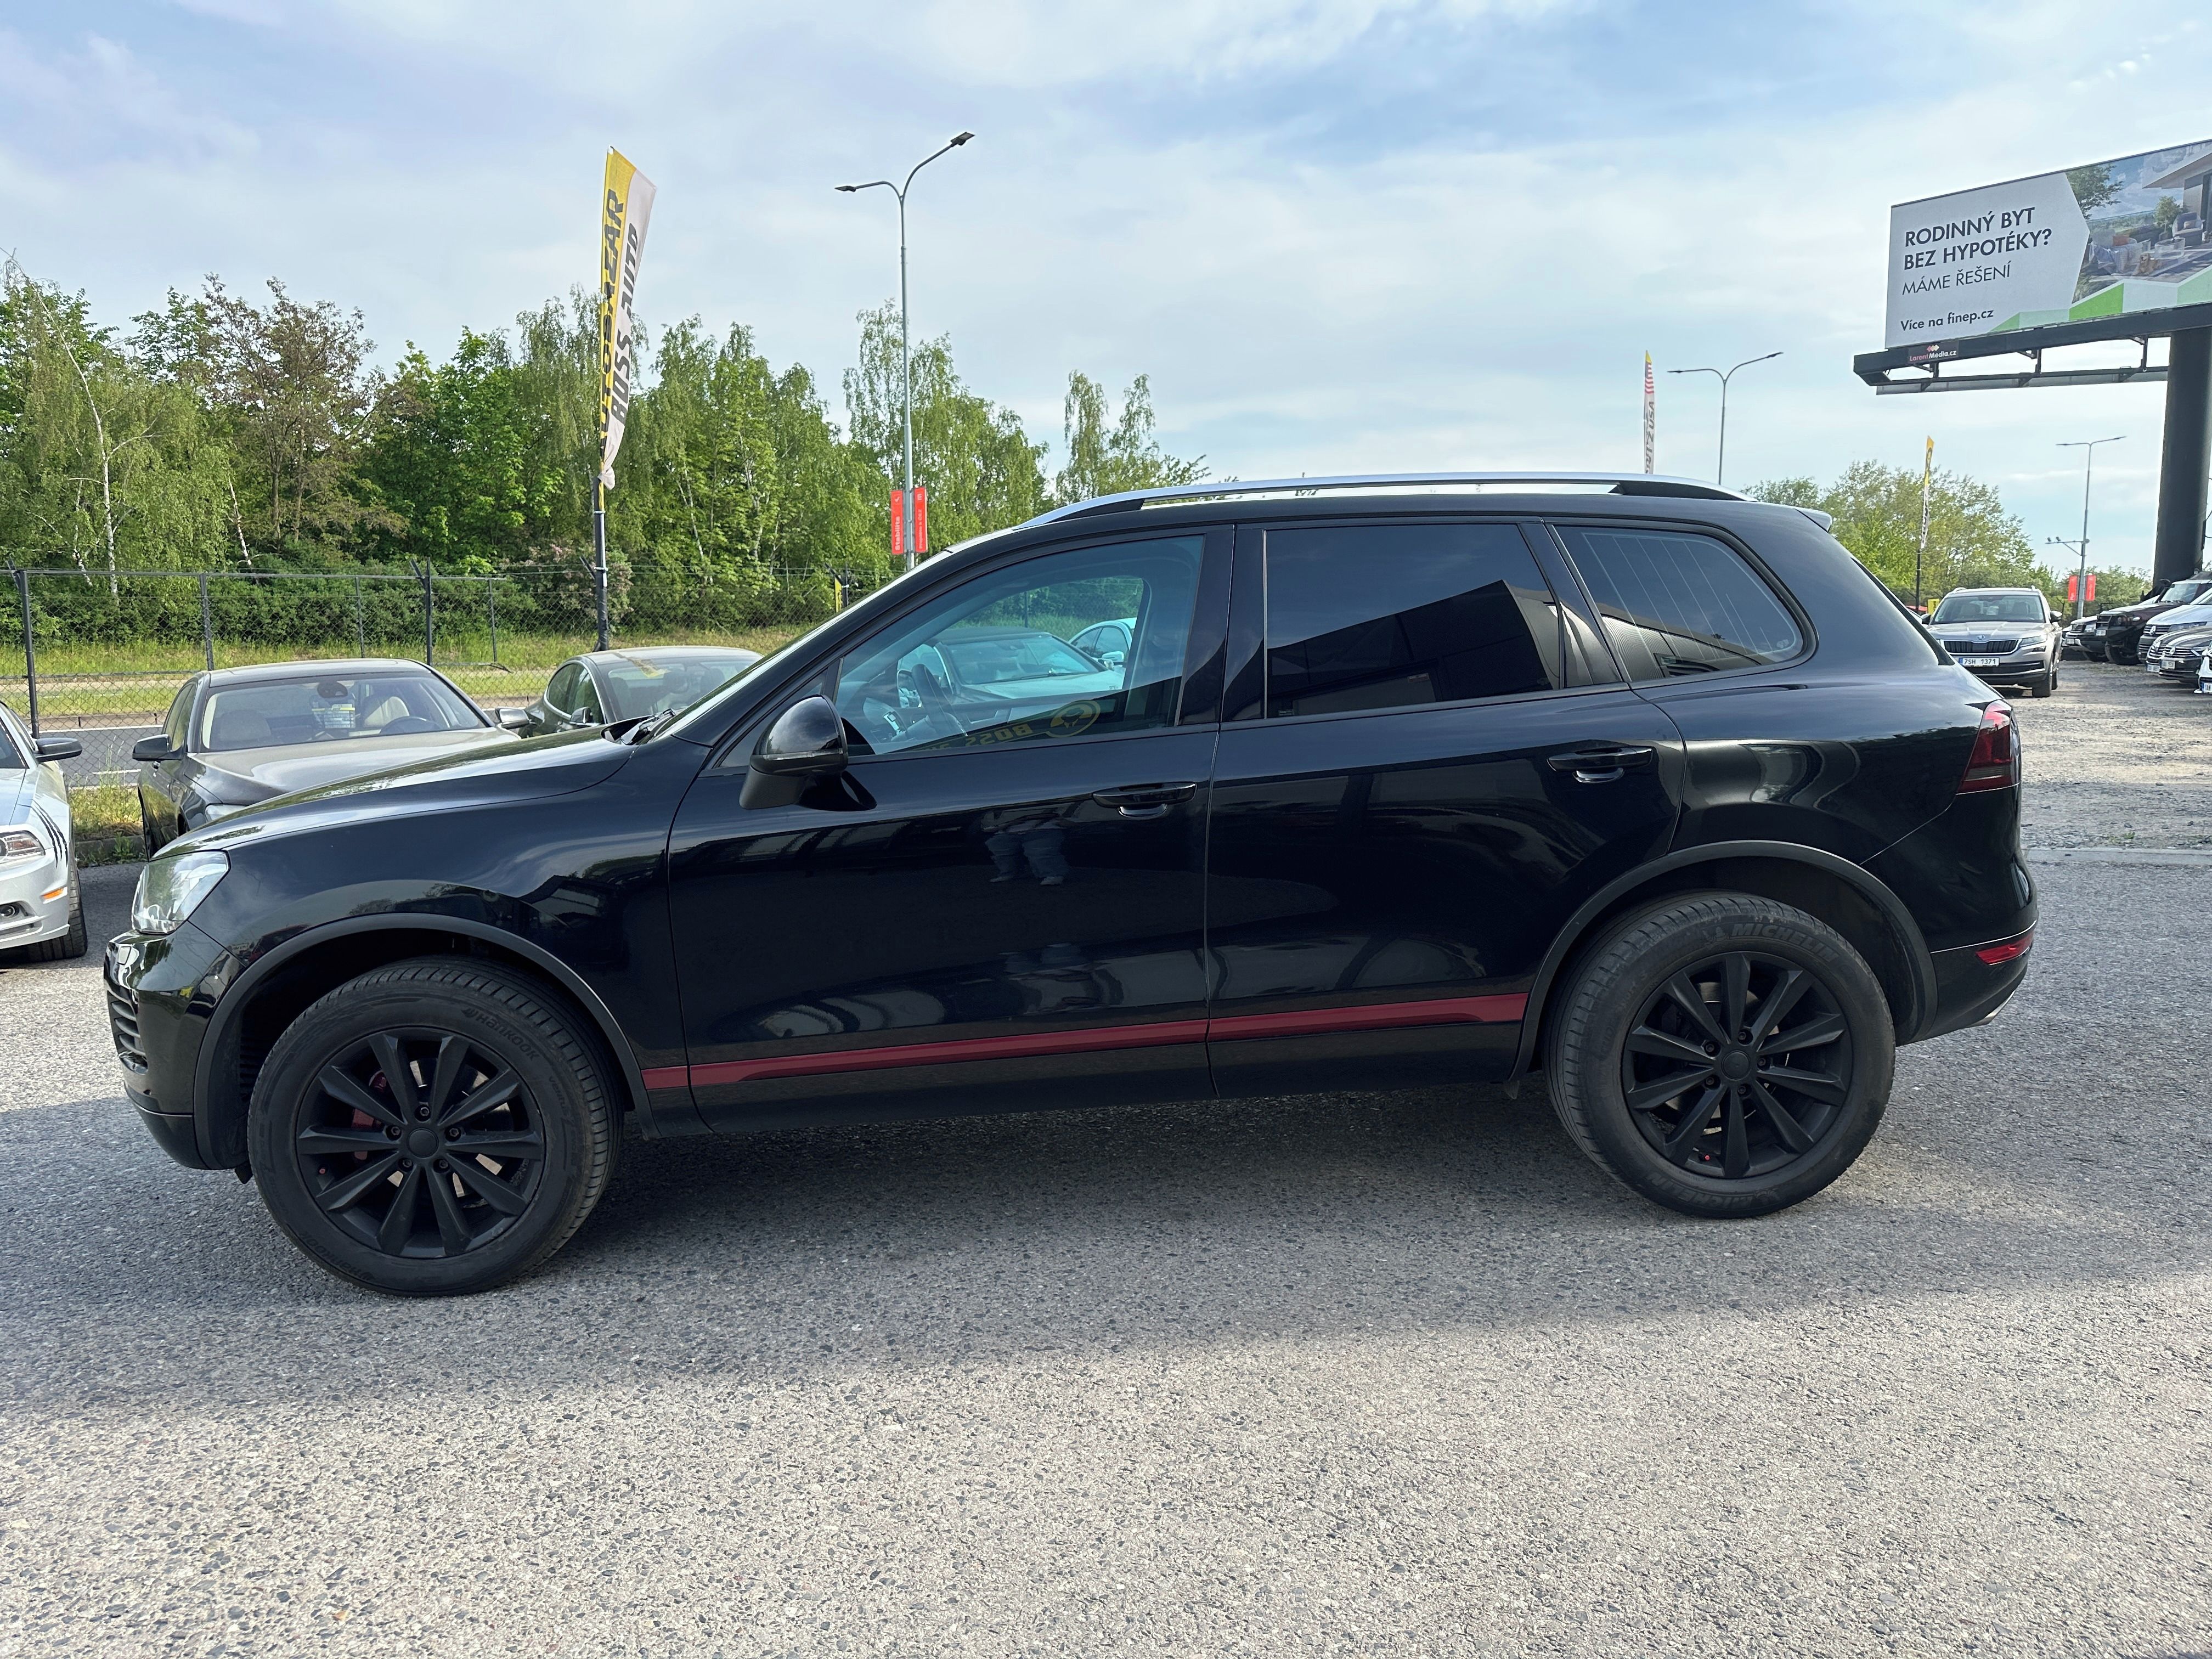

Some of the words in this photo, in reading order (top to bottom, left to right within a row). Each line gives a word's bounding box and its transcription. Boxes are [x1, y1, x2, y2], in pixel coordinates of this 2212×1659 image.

[1905, 211, 1995, 247] RODINNÝ
[2001, 207, 2035, 229] BYT
[1904, 250, 1937, 270] BEZ
[1943, 228, 2052, 263] HYPOTÉKY?
[1902, 276, 1950, 295] MÁME
[1956, 261, 2012, 286] ŘEŠENÍ
[1900, 319, 1925, 331] Více
[1928, 318, 1943, 328] na
[1948, 310, 1994, 324] finep.cz
[1909, 350, 1957, 362] LarentMedia.cz
[611, 328, 631, 426] BOSS
[1731, 923, 1840, 962] MICHELIN
